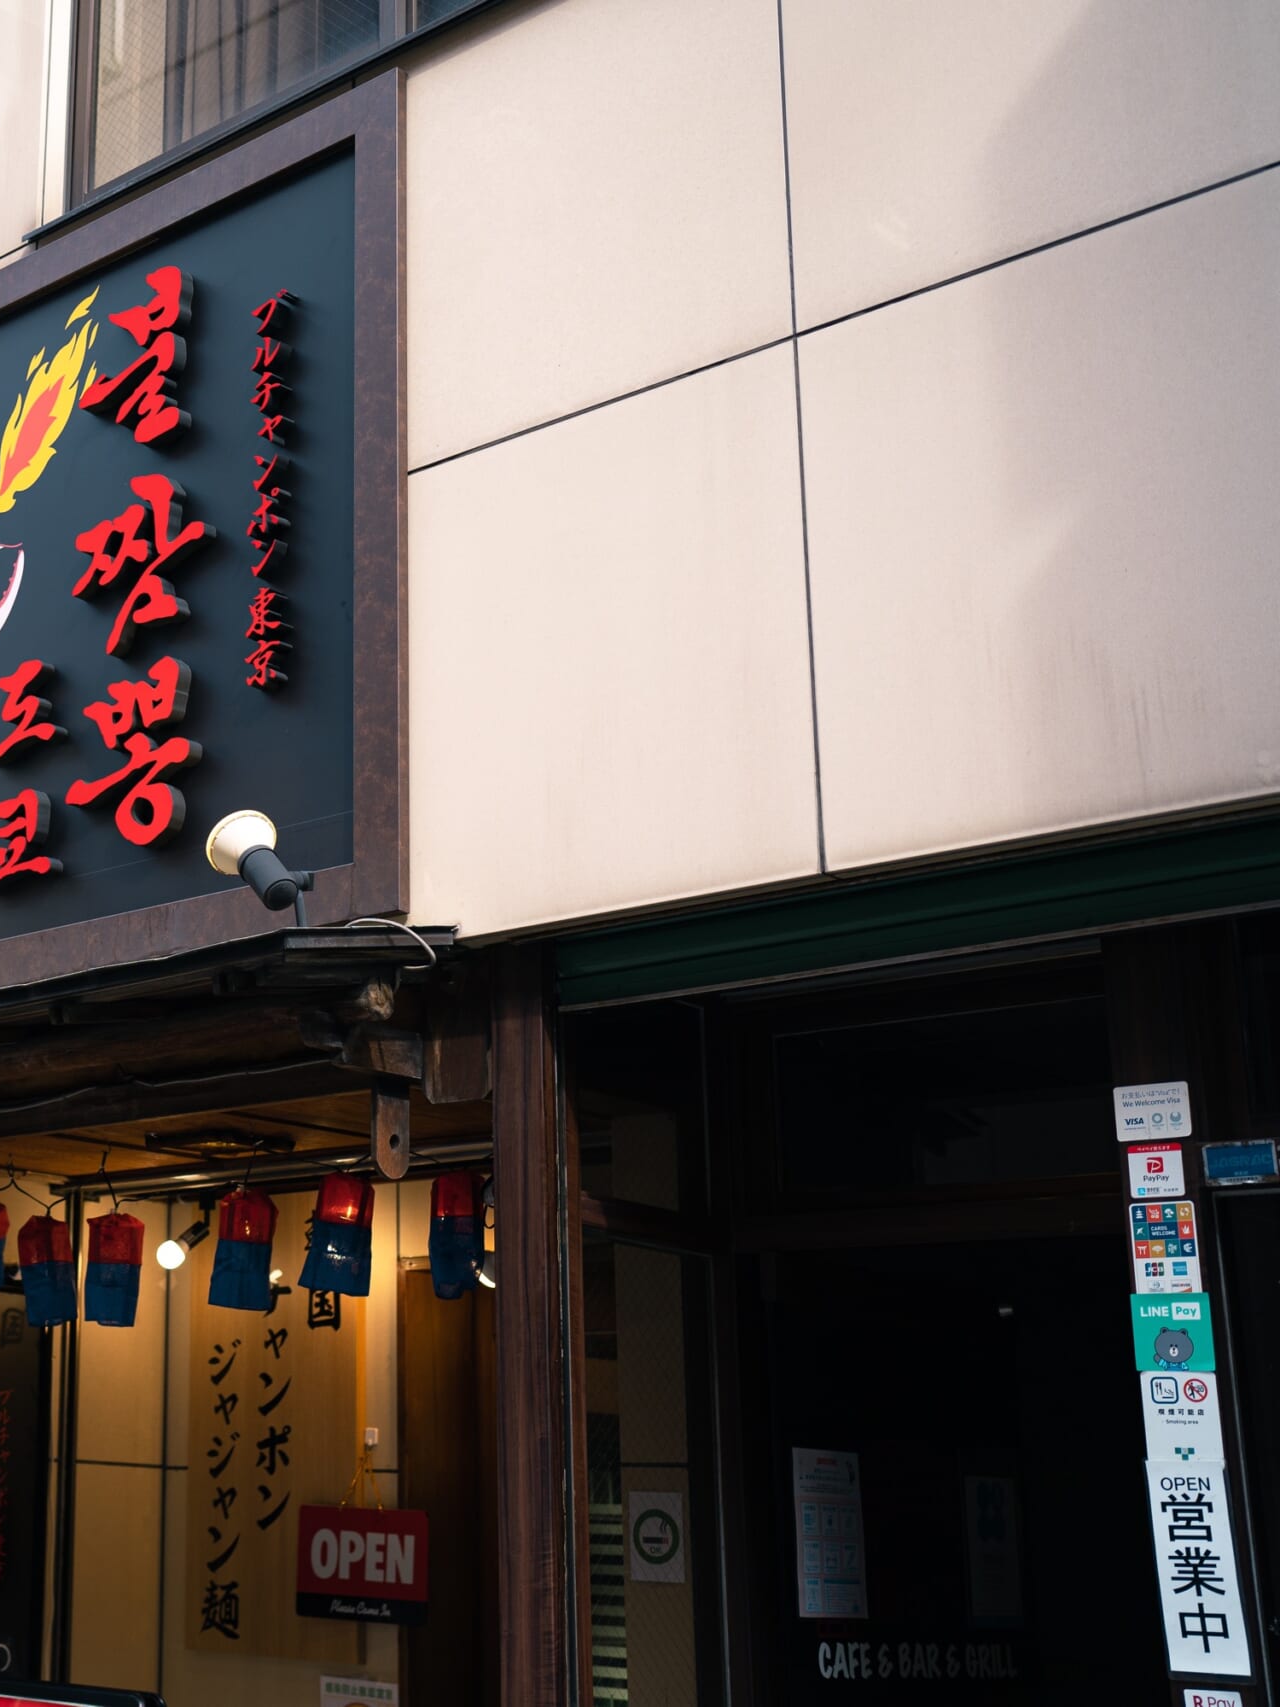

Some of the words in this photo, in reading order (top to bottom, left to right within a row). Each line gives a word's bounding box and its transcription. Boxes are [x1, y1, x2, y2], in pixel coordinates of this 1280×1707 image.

[245, 288, 288, 690] ブルチャンポン東京
[1124, 1117, 1144, 1125] VISA
[1140, 1306, 1169, 1317] LINE
[1175, 1306, 1197, 1317] Pay
[1160, 1476, 1212, 1492] OPEN
[311, 1528, 415, 1585] OPEN
[1160, 1493, 1231, 1654] 営業中
[330, 1600, 355, 1614] Please
[356, 1601, 379, 1616] Come
[380, 1604, 391, 1616] In
[818, 1641, 873, 1680] CAFE
[877, 1643, 894, 1679] &
[898, 1642, 942, 1679] BAR
[964, 1643, 1019, 1680] GRILL
[1193, 1696, 1203, 1707] R
